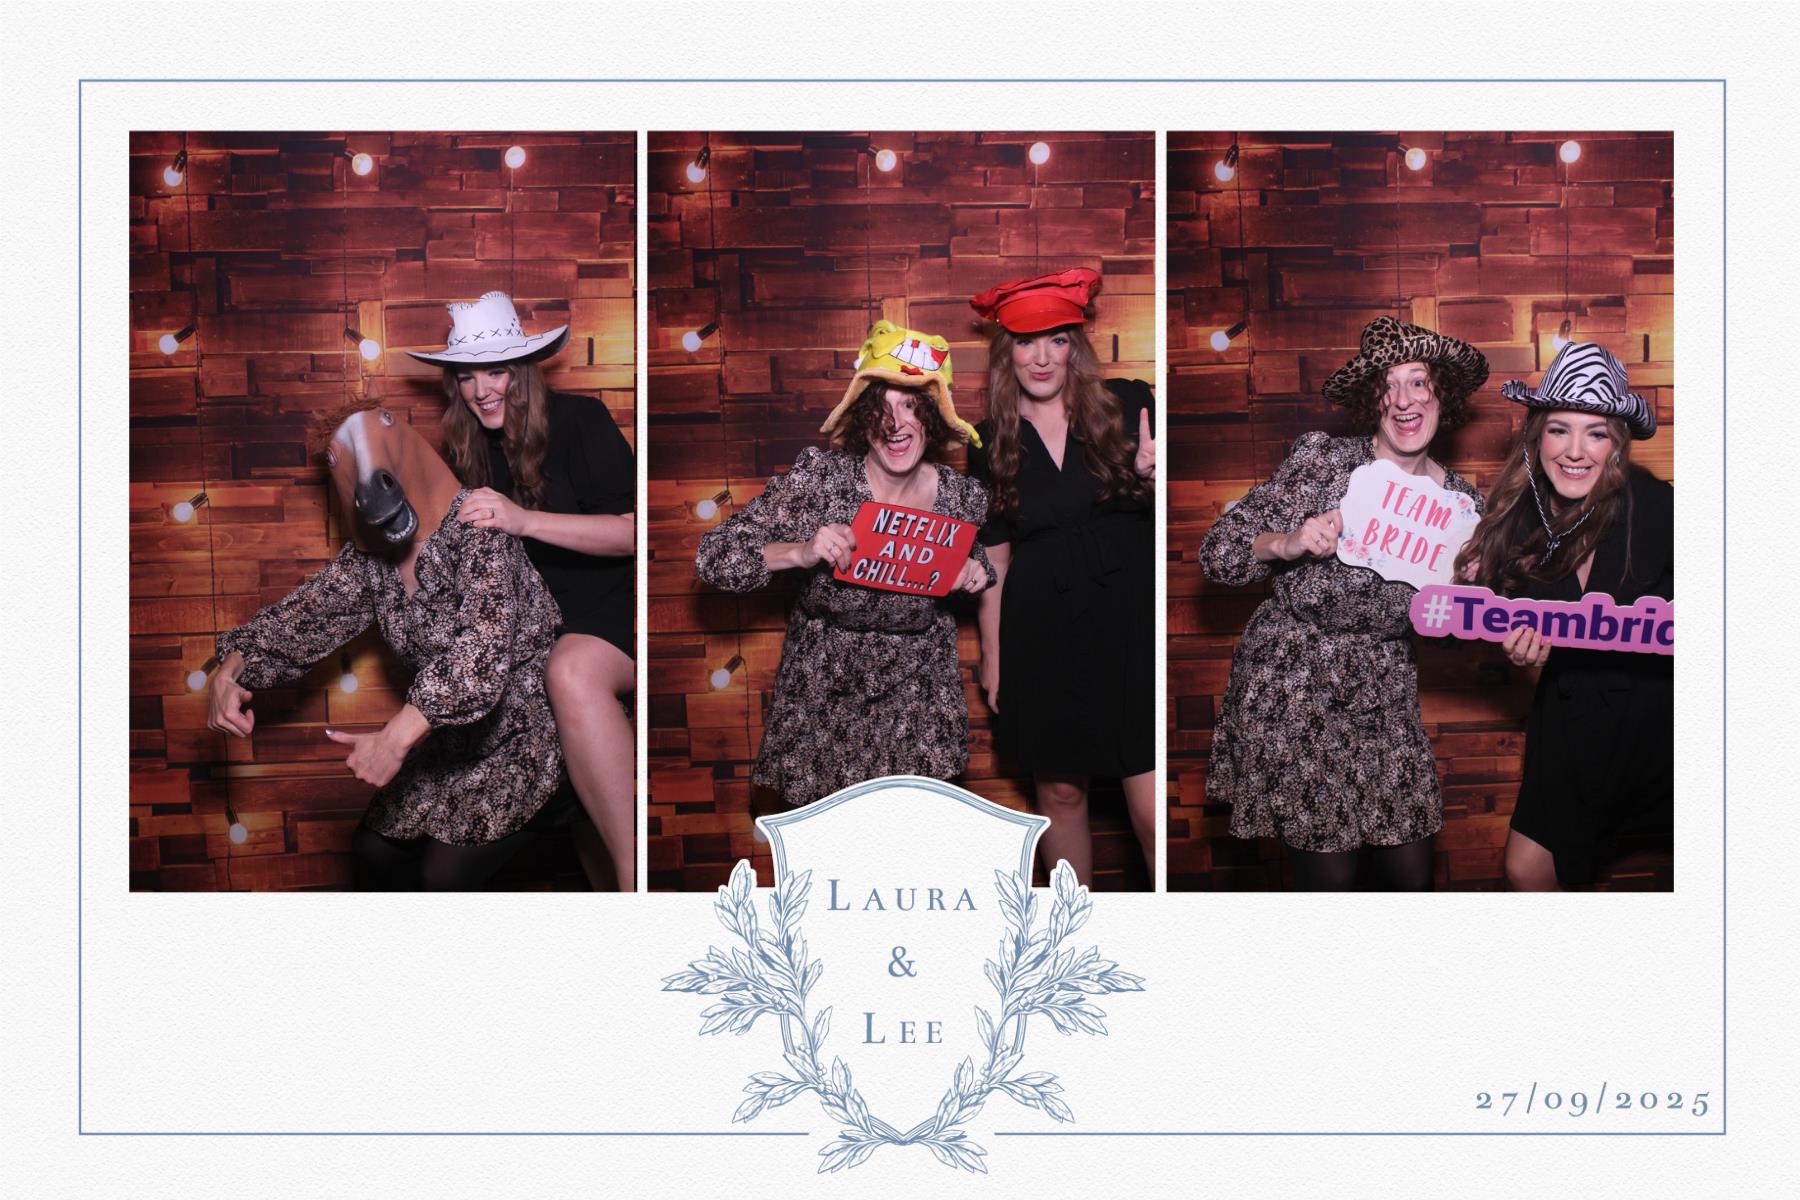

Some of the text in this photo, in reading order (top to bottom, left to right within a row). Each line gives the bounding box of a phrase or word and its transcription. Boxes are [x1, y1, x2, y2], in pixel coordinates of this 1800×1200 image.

[1382, 480, 1452, 531] TEAM
[872, 508, 961, 548] NETFLIX
[1362, 517, 1447, 572] BRIDE
[879, 540, 934, 564] AND
[853, 558, 940, 592] CHILL...?
